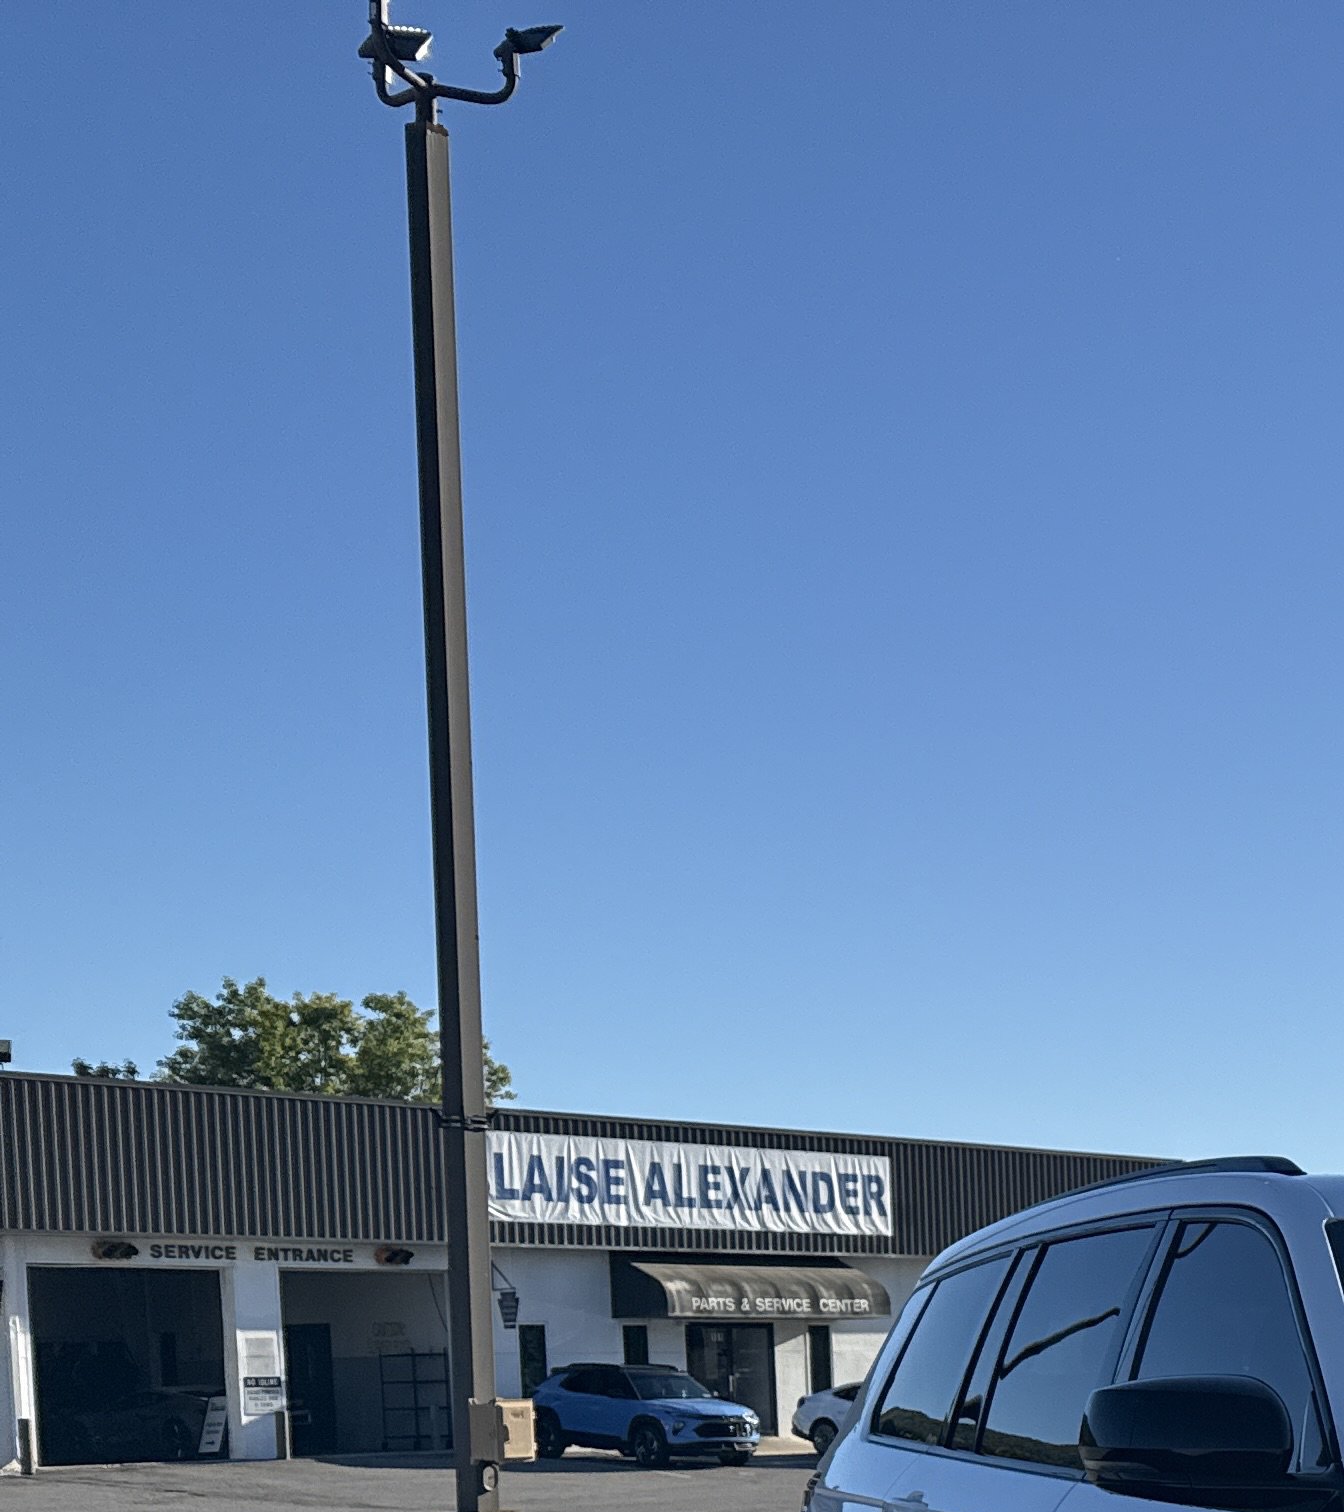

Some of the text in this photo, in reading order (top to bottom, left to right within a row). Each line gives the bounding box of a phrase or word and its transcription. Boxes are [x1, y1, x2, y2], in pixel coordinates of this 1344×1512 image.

[493, 1151, 888, 1217] LAISE ALEXANDER
[150, 1243, 354, 1263] SERVICE ENTRANCE
[692, 1296, 870, 1313] PARTS & SERVICE CENTER
